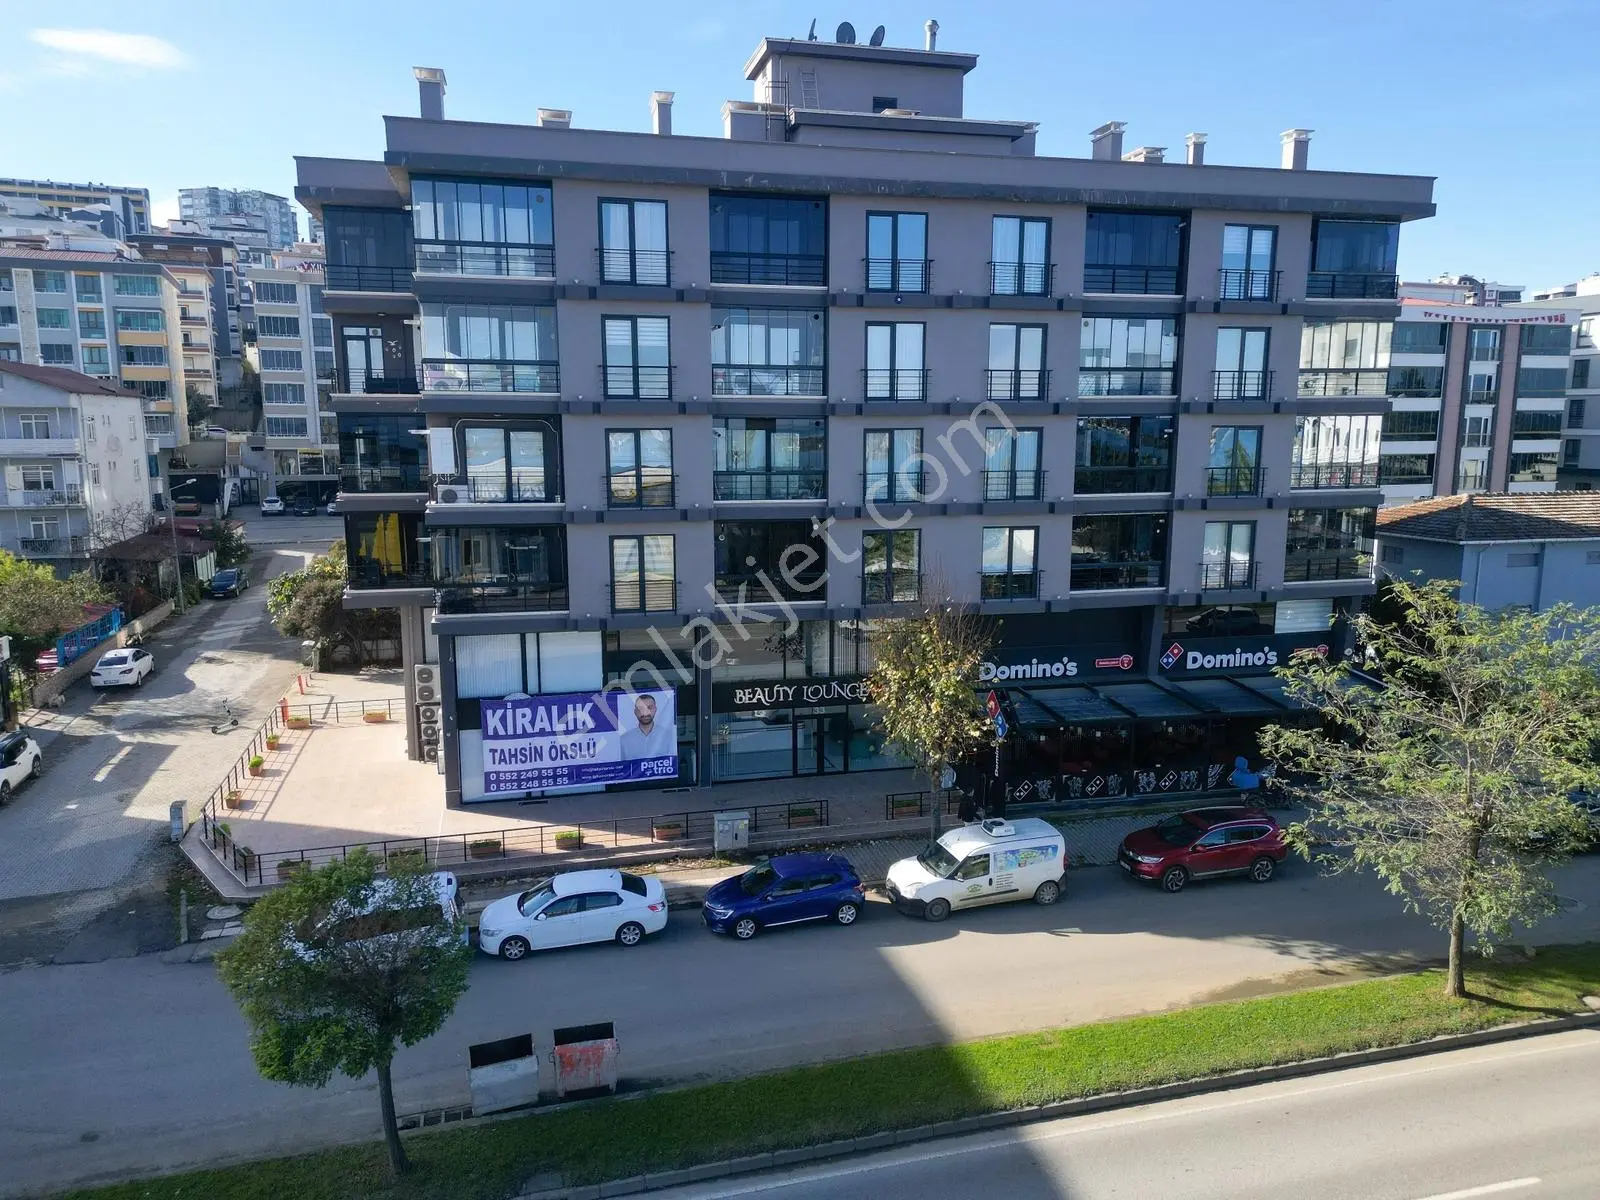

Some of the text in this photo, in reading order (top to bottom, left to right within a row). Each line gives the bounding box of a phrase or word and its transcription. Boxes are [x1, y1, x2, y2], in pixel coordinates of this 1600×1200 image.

[979, 656, 1078, 681] Domino's
[1186, 646, 1278, 670] Domino's
[734, 681, 868, 706] BEAUTY LOUNGE
[487, 703, 597, 736] KİRALIK
[489, 738, 597, 765] TAHSİN ÖRSLÜ
[489, 767, 569, 781] 0 552 249 55 55
[640, 756, 673, 772] parcel
[653, 766, 674, 774] trio
[490, 777, 569, 791] 0 552 248 55 55
